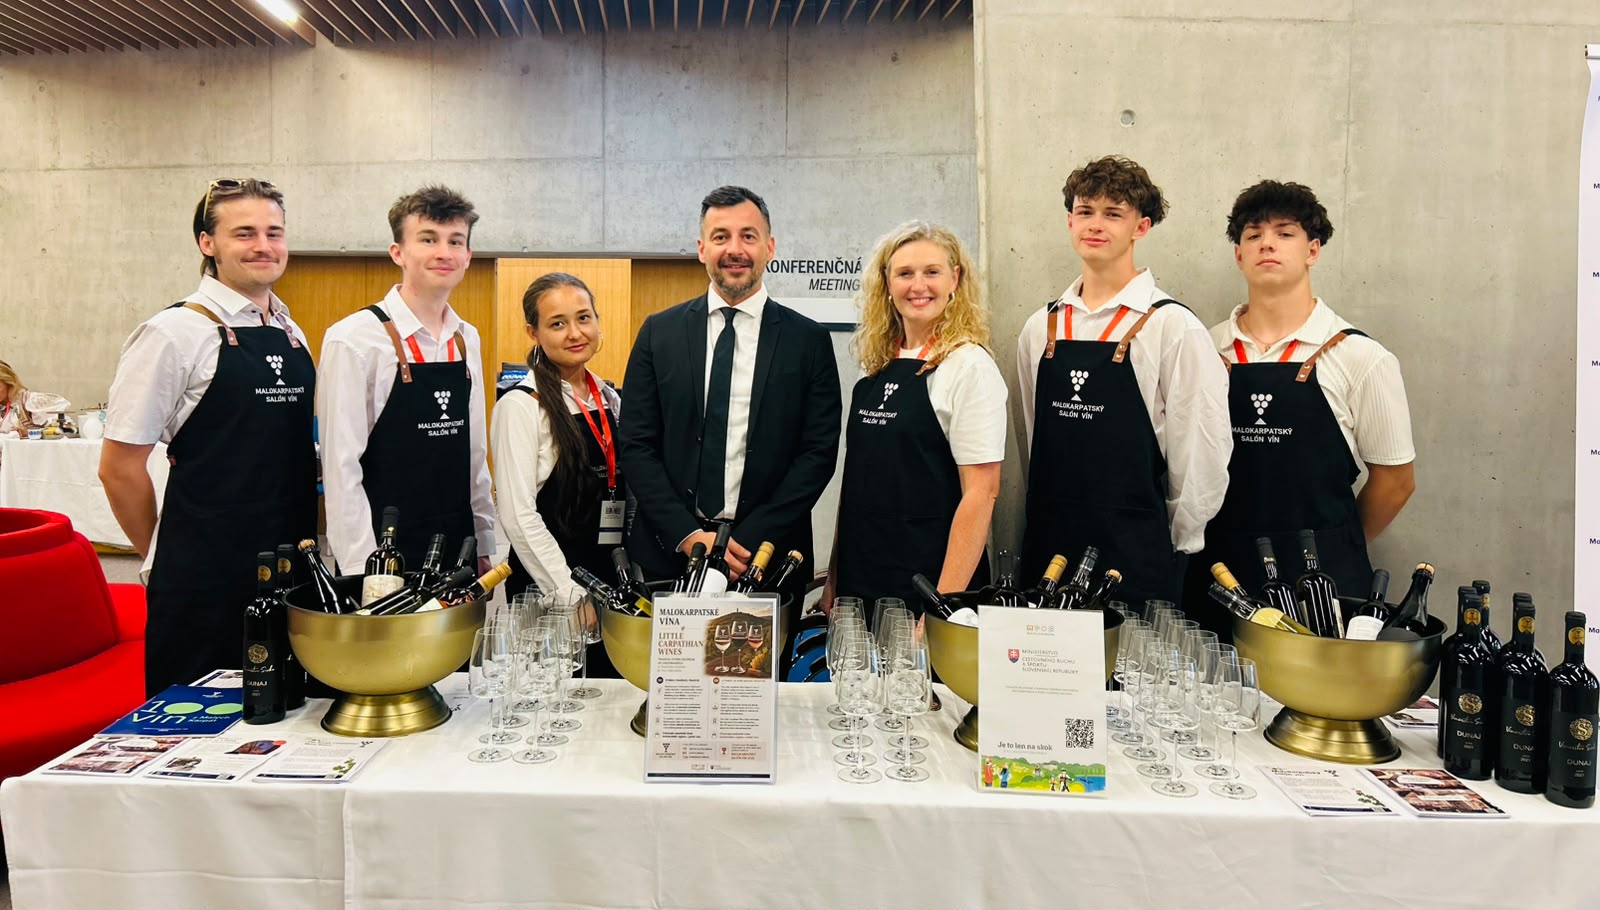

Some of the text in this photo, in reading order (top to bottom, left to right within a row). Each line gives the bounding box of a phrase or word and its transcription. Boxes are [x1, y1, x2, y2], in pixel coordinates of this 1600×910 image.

[809, 278, 860, 291] MEETING
[255, 386, 304, 394] MALOKARPATSKÝ
[1052, 401, 1104, 412] MALOKARPATSKÝ
[660, 608, 720, 616] MALOKARPATSKÉ
[658, 640, 704, 648] CARPATHIAN
